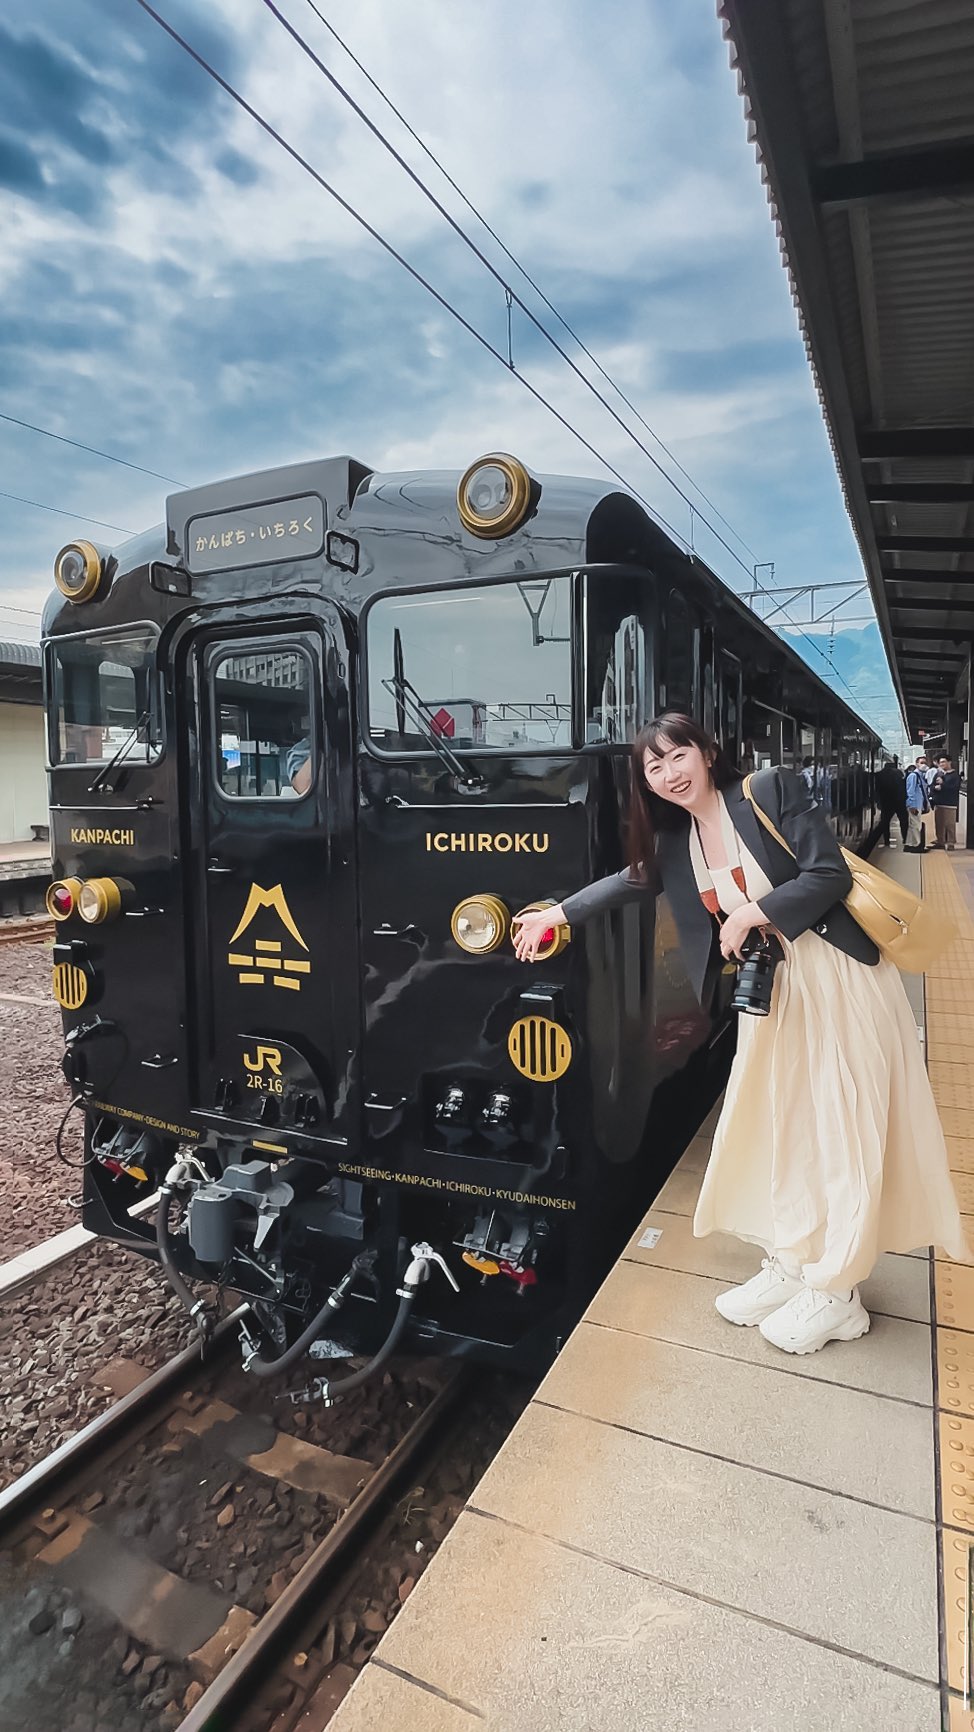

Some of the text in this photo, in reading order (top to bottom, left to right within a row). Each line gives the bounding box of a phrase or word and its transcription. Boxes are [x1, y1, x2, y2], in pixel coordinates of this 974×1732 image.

[71, 828, 134, 845] KANPACHI
[426, 832, 550, 853] ICHIROKU
[243, 1046, 283, 1076] JR
[246, 1074, 283, 1094] 2R-16
[167, 1122, 180, 1134] AND
[180, 1127, 200, 1139] STORY
